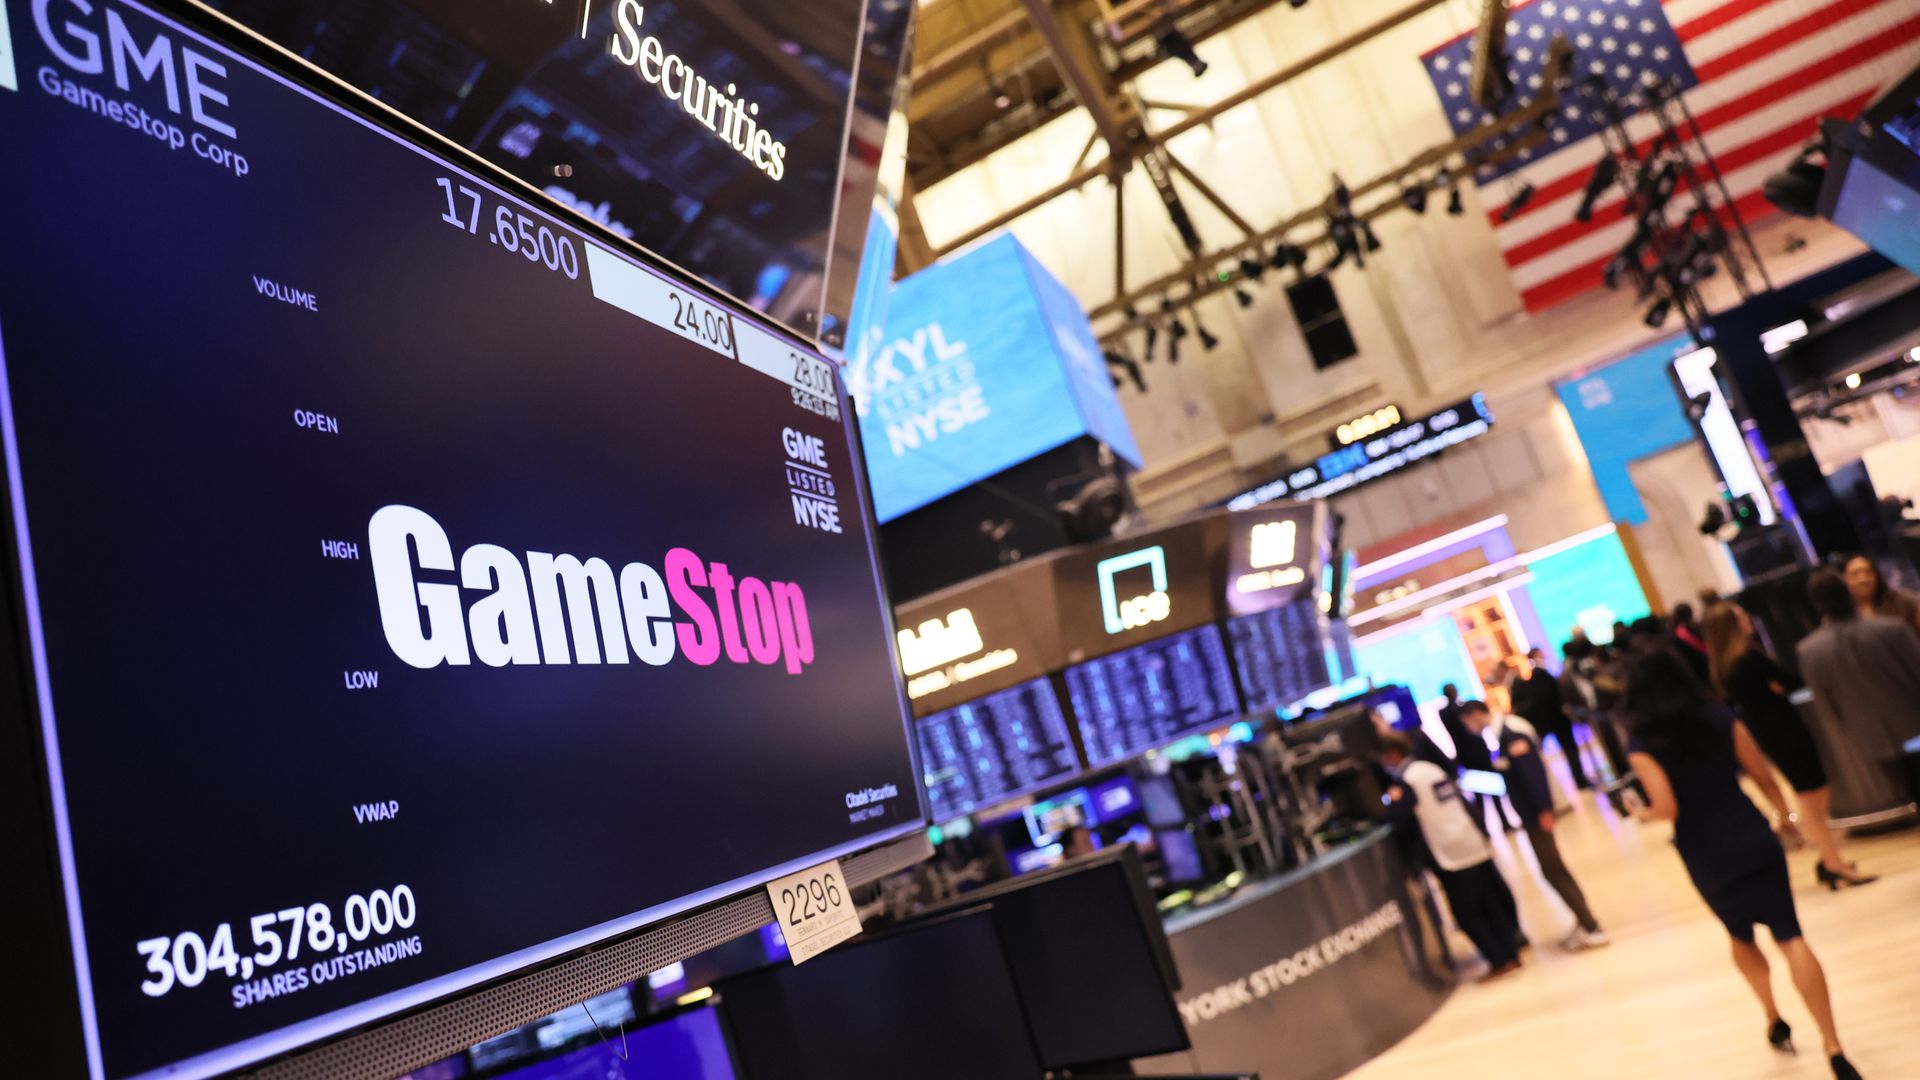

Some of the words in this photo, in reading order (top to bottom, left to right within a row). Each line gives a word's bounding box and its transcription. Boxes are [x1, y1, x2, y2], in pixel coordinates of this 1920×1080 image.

[31, 0, 238, 140] GME
[611, 0, 787, 182] Securities
[37, 66, 185, 149] GameStop
[191, 132, 250, 177] Corp
[435, 177, 579, 281] 17.6500
[252, 275, 318, 312] VOLUME
[669, 292, 732, 351] 24.00
[294, 409, 339, 434] OPEN
[782, 427, 828, 469] GME
[886, 384, 991, 457] NYSE
[786, 468, 836, 497] LISTED
[791, 494, 843, 534] NYSE
[321, 538, 360, 561] HIGH
[367, 503, 815, 675] GameStop
[344, 670, 379, 690] LOW
[353, 800, 400, 824] VWAP
[782, 872, 842, 927] 2296
[136, 883, 417, 998] 304,578,000
[231, 967, 310, 1009] SHARES
[311, 935, 423, 985] OUTSTANDING
[1249, 944, 1324, 999] STOCK
